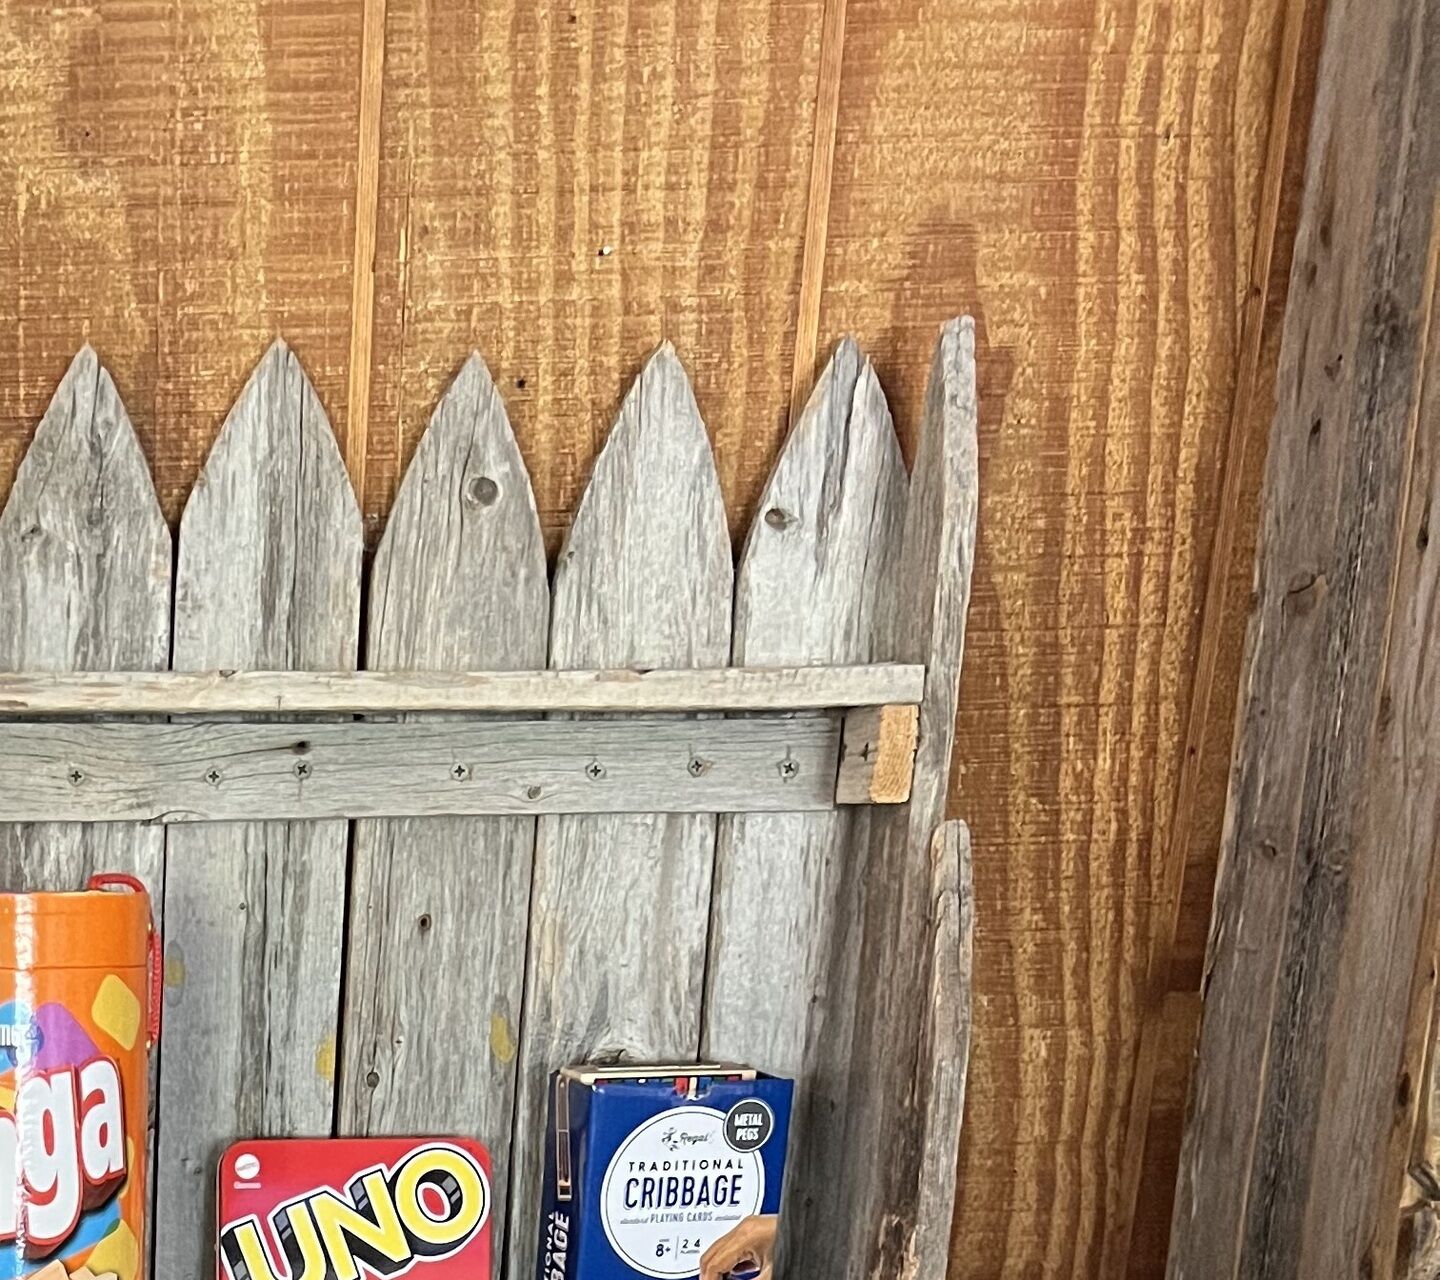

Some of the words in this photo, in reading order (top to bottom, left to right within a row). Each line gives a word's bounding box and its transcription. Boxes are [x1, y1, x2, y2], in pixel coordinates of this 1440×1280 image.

[734, 1113, 763, 1127] METAL
[735, 1128, 759, 1141] PEGS
[629, 1159, 744, 1173] TRADITIONAL
[624, 1174, 743, 1209] CRIBBAGE
[650, 1213, 684, 1224] PLAYING
[687, 1211, 713, 1222] CARDS
[656, 1244, 670, 1257] 8+
